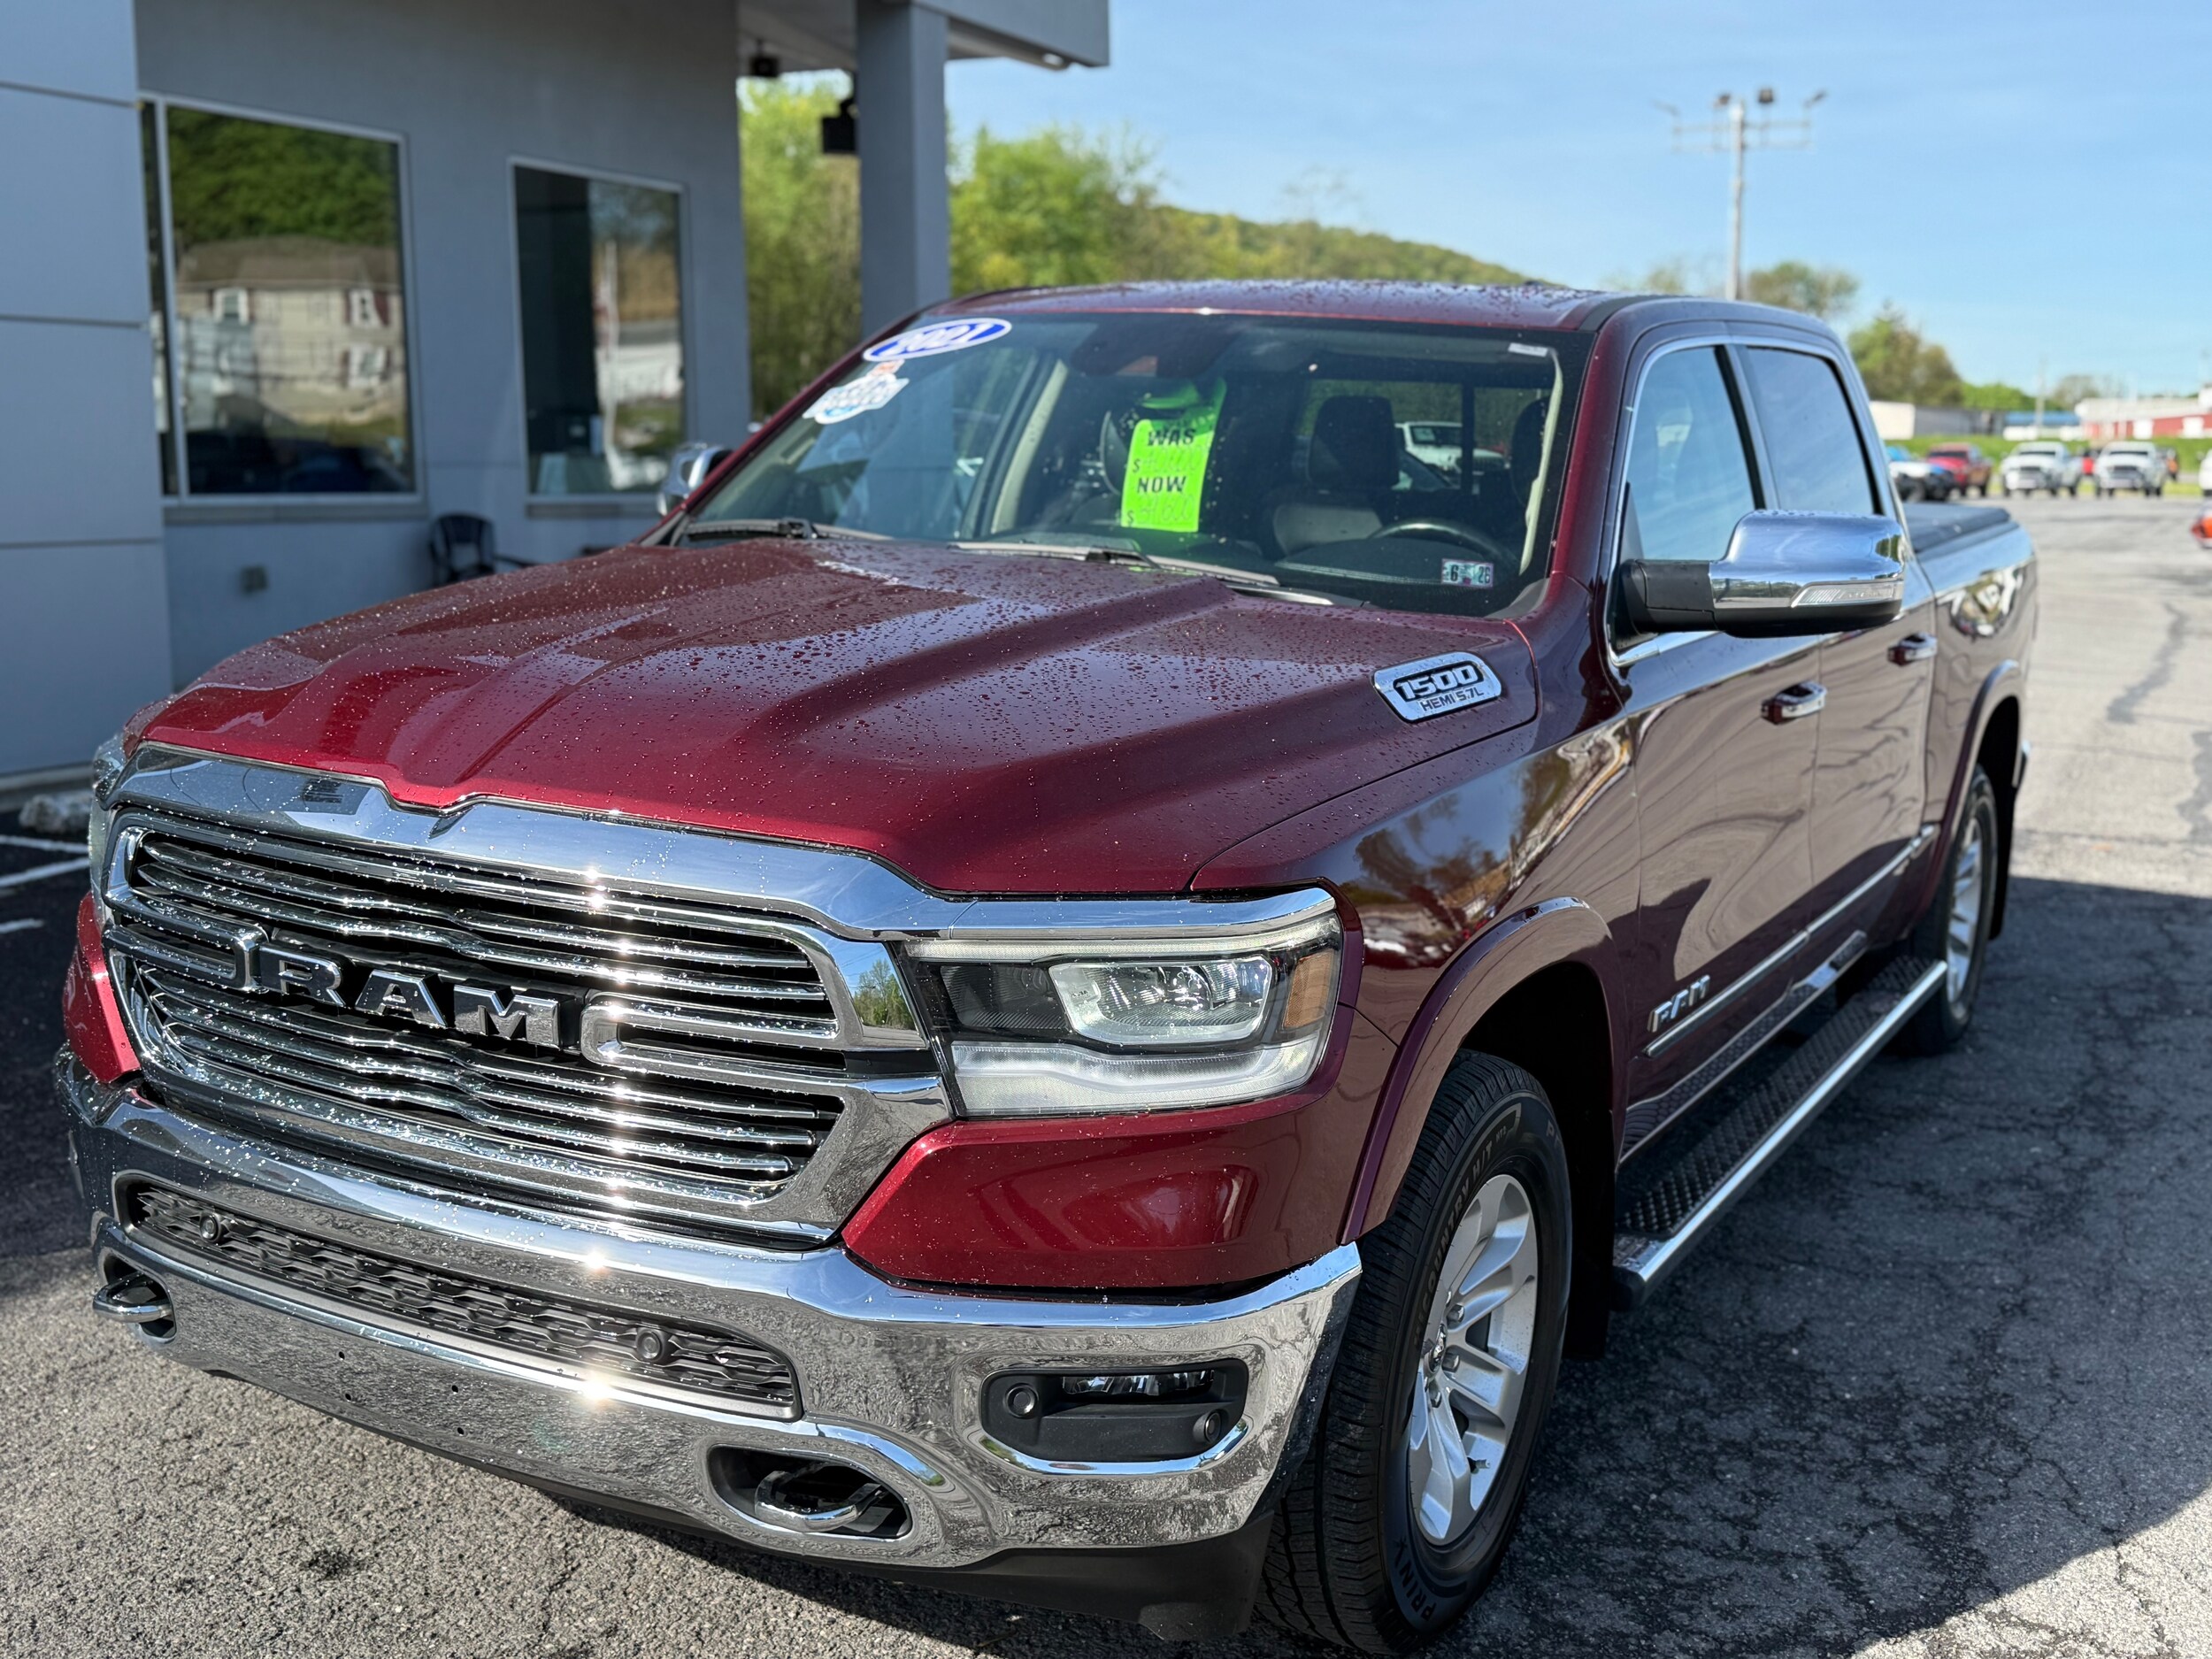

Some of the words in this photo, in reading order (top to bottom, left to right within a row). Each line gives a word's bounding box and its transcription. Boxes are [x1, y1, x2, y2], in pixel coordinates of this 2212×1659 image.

[1147, 428, 1196, 446] WAS
[1137, 476, 1187, 494] NOW
[1449, 565, 1459, 581] 6
[1395, 664, 1479, 700] 1500
[1420, 693, 1455, 711] HEMI
[1456, 687, 1485, 702] 5.7L
[260, 943, 567, 1050] RAM
